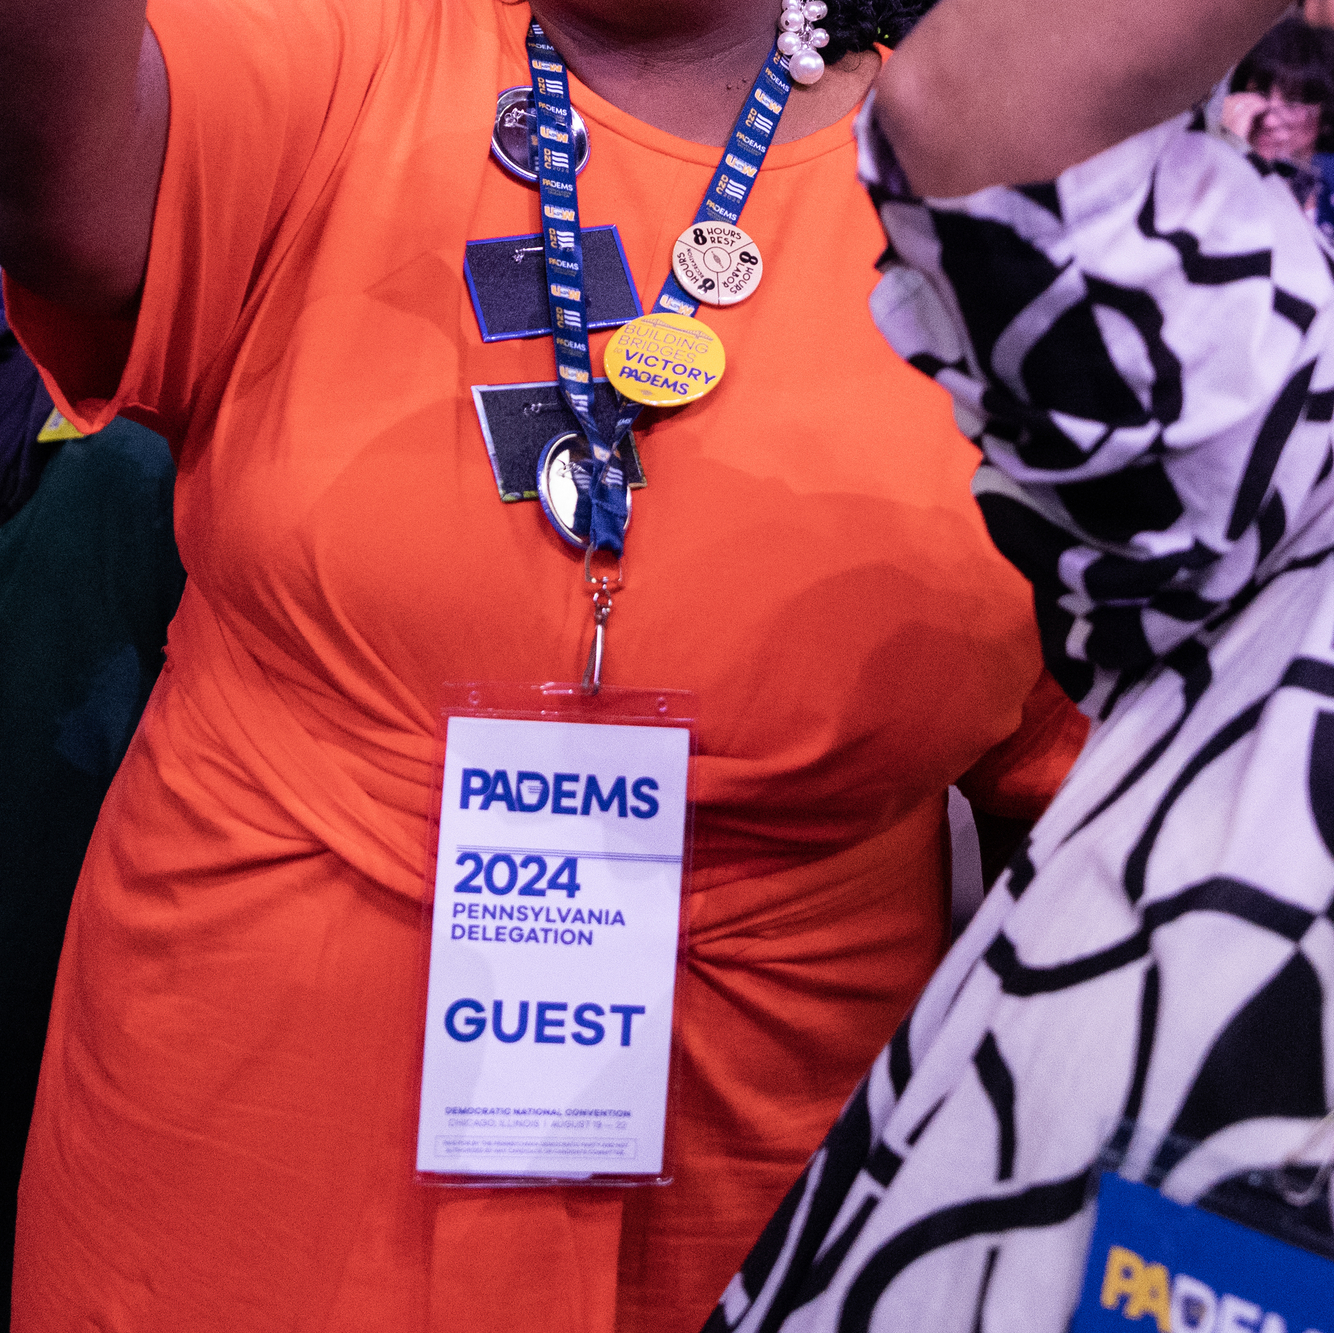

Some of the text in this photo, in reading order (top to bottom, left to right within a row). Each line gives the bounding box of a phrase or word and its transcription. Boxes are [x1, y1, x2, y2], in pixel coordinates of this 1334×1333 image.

[537, 77, 547, 95] DNC
[765, 67, 790, 93] PADEMS
[538, 102, 568, 116] PADEMS
[755, 87, 783, 115] USW
[745, 107, 758, 127] DNC
[540, 125, 569, 144] USW
[736, 131, 767, 153] PADEMS
[543, 148, 552, 170] DNC
[725, 153, 758, 178] USW
[542, 178, 574, 192] PADEMS
[716, 174, 729, 195] DNC
[544, 204, 575, 222] USW
[706, 199, 738, 221] PADEMS
[693, 228, 742, 246] 8 HOURS
[710, 236, 736, 247] REST
[548, 257, 579, 271] PADEMS
[677, 252, 715, 295] 8 HOURS
[687, 248, 705, 279] RECREATION
[722, 262, 745, 288] LABOR
[730, 251, 758, 294] 8 HOURS
[550, 283, 582, 302] USW
[556, 306, 565, 329] DNC
[659, 294, 695, 318] USW
[556, 337, 587, 352] PADEMS
[618, 335, 696, 364] BRIDGES
[624, 324, 709, 354] BUILDING
[559, 364, 589, 383] USW
[625, 349, 716, 385] VICTORY
[619, 366, 689, 396] PADEMS
[459, 768, 660, 819] PADEMS
[453, 851, 581, 899] 2024
[451, 902, 626, 927] PENNSYLVANIA
[451, 923, 594, 946] DELEGATION
[444, 997, 646, 1047] GUEST
[445, 1106, 632, 1117] DEMOCRATIC NATIONAL CONVENTION
